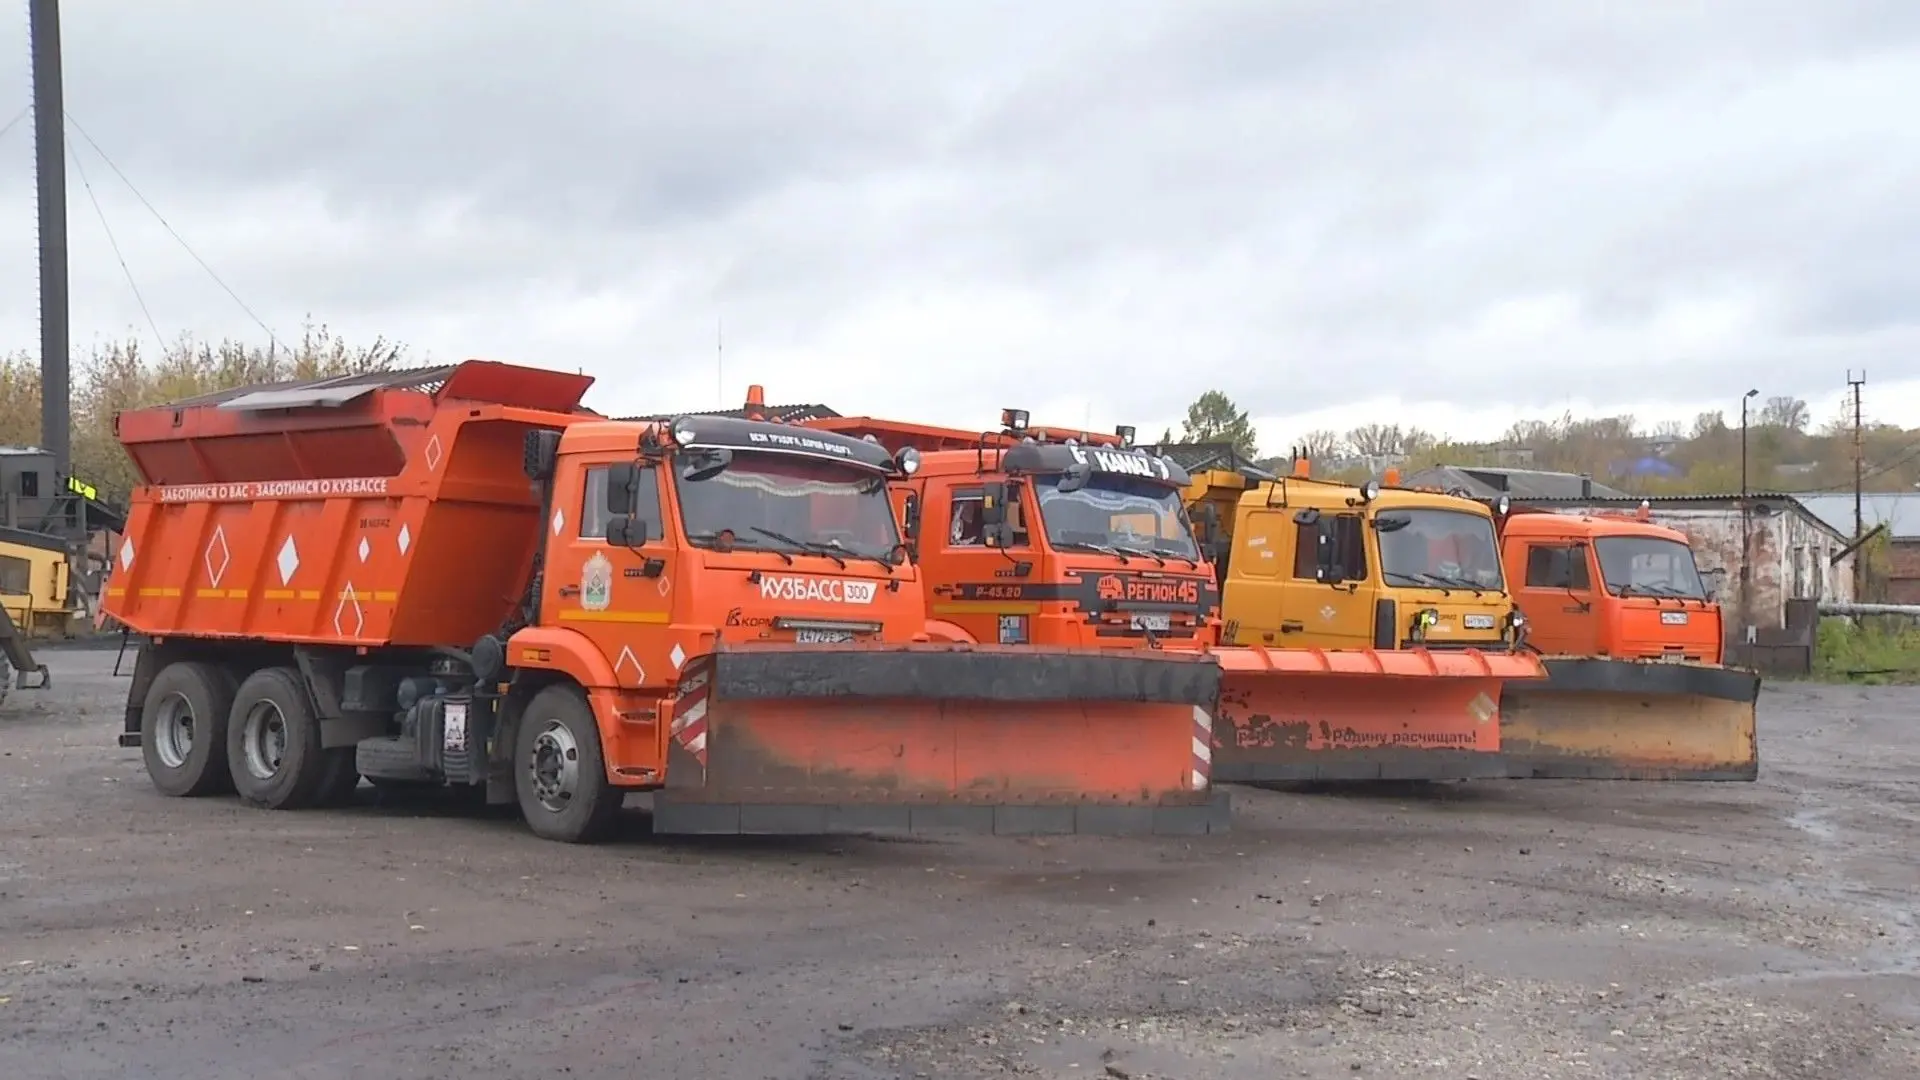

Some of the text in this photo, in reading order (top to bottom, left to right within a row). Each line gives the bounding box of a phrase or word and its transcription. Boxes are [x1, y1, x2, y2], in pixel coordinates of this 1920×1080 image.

[1094, 452, 1155, 477] KAMAZ
[160, 486, 217, 501] ЗАБОТИМСЯ
[219, 486, 228, 498] О
[230, 485, 248, 498] ВАС
[256, 482, 319, 497] ЗАБОТИМСЯ
[321, 481, 330, 493] О
[332, 479, 387, 493] КУЗБАССЕ
[760, 576, 869, 602] КУЗБАСС 300
[1127, 580, 1198, 603] РЕГИОН 45
[1392, 730, 1477, 745] расчищать!
